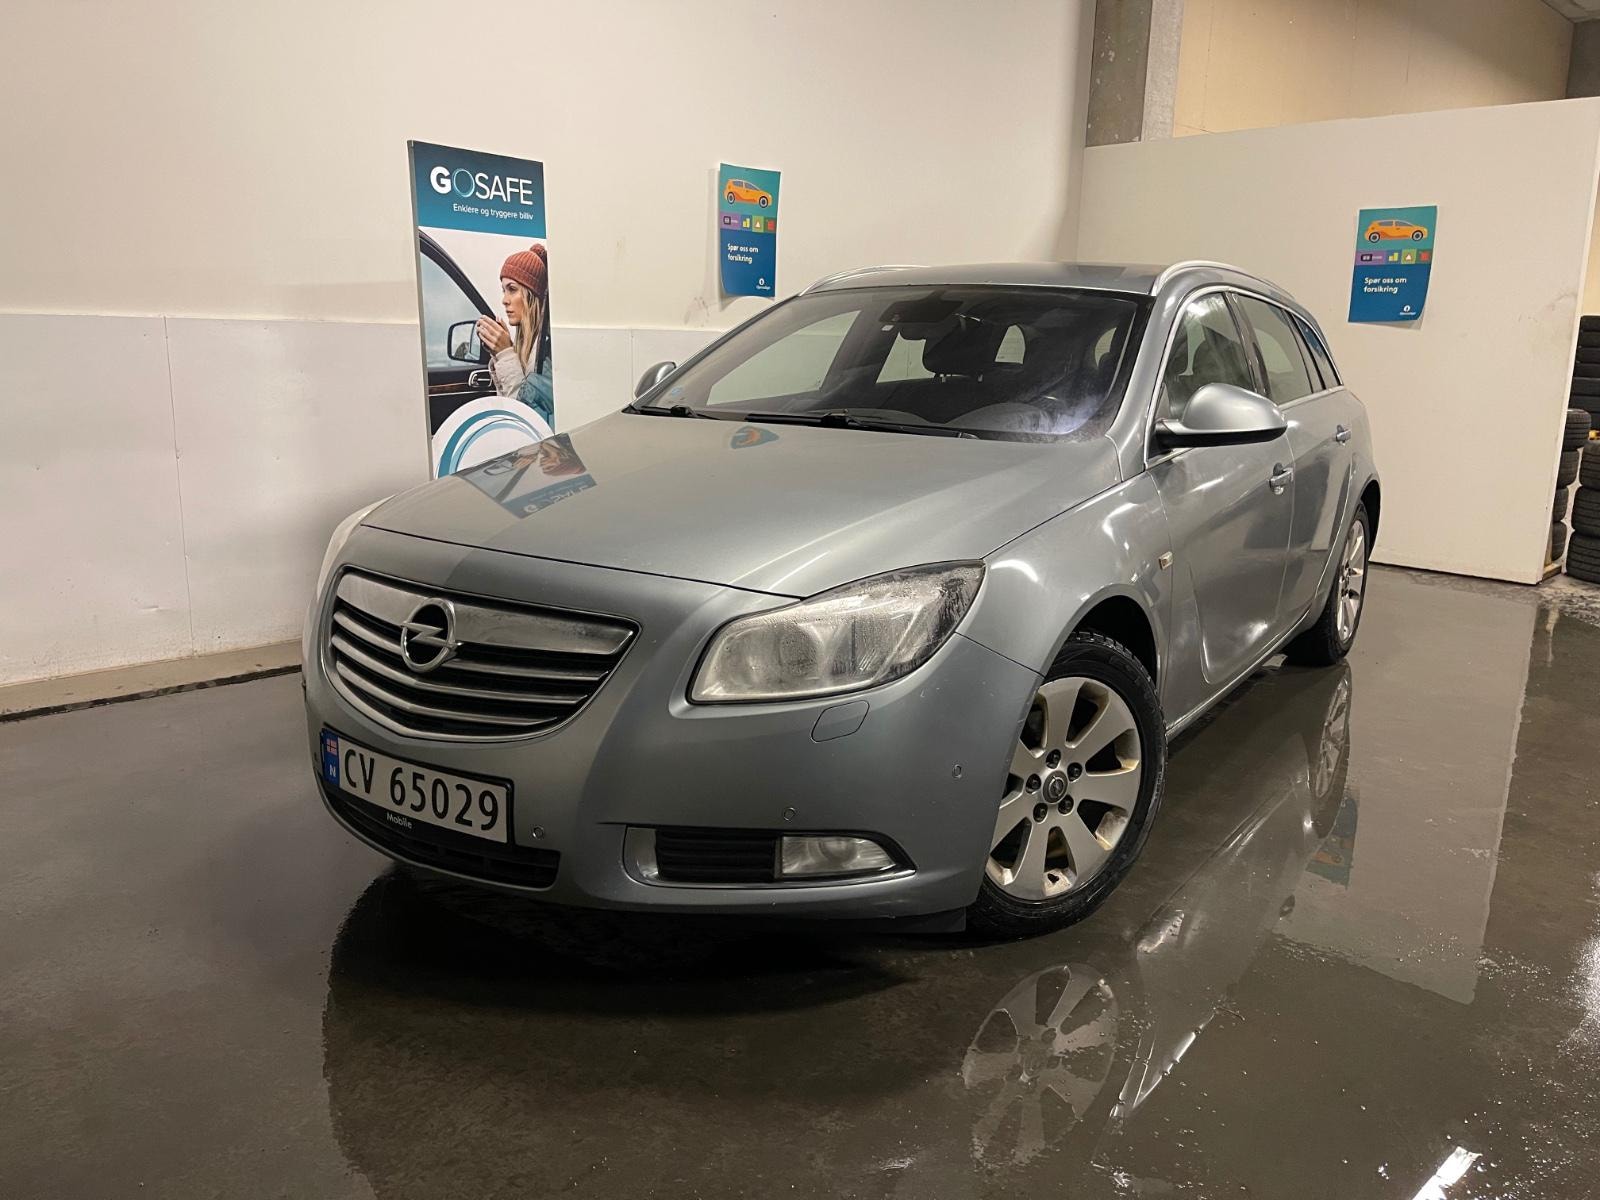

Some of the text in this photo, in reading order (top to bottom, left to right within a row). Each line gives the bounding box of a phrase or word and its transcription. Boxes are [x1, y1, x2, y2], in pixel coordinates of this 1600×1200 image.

[430, 166, 533, 205] GOSAFE
[480, 208, 490, 216] og
[490, 208, 518, 219] tryggere
[519, 211, 534, 220] billiv
[727, 253, 753, 264] forsikring
[1364, 277, 1381, 285] Spør
[1363, 286, 1399, 294] forsikring
[329, 764, 337, 778] N
[344, 749, 499, 831] CV 65029
[386, 811, 413, 829] Mobile
